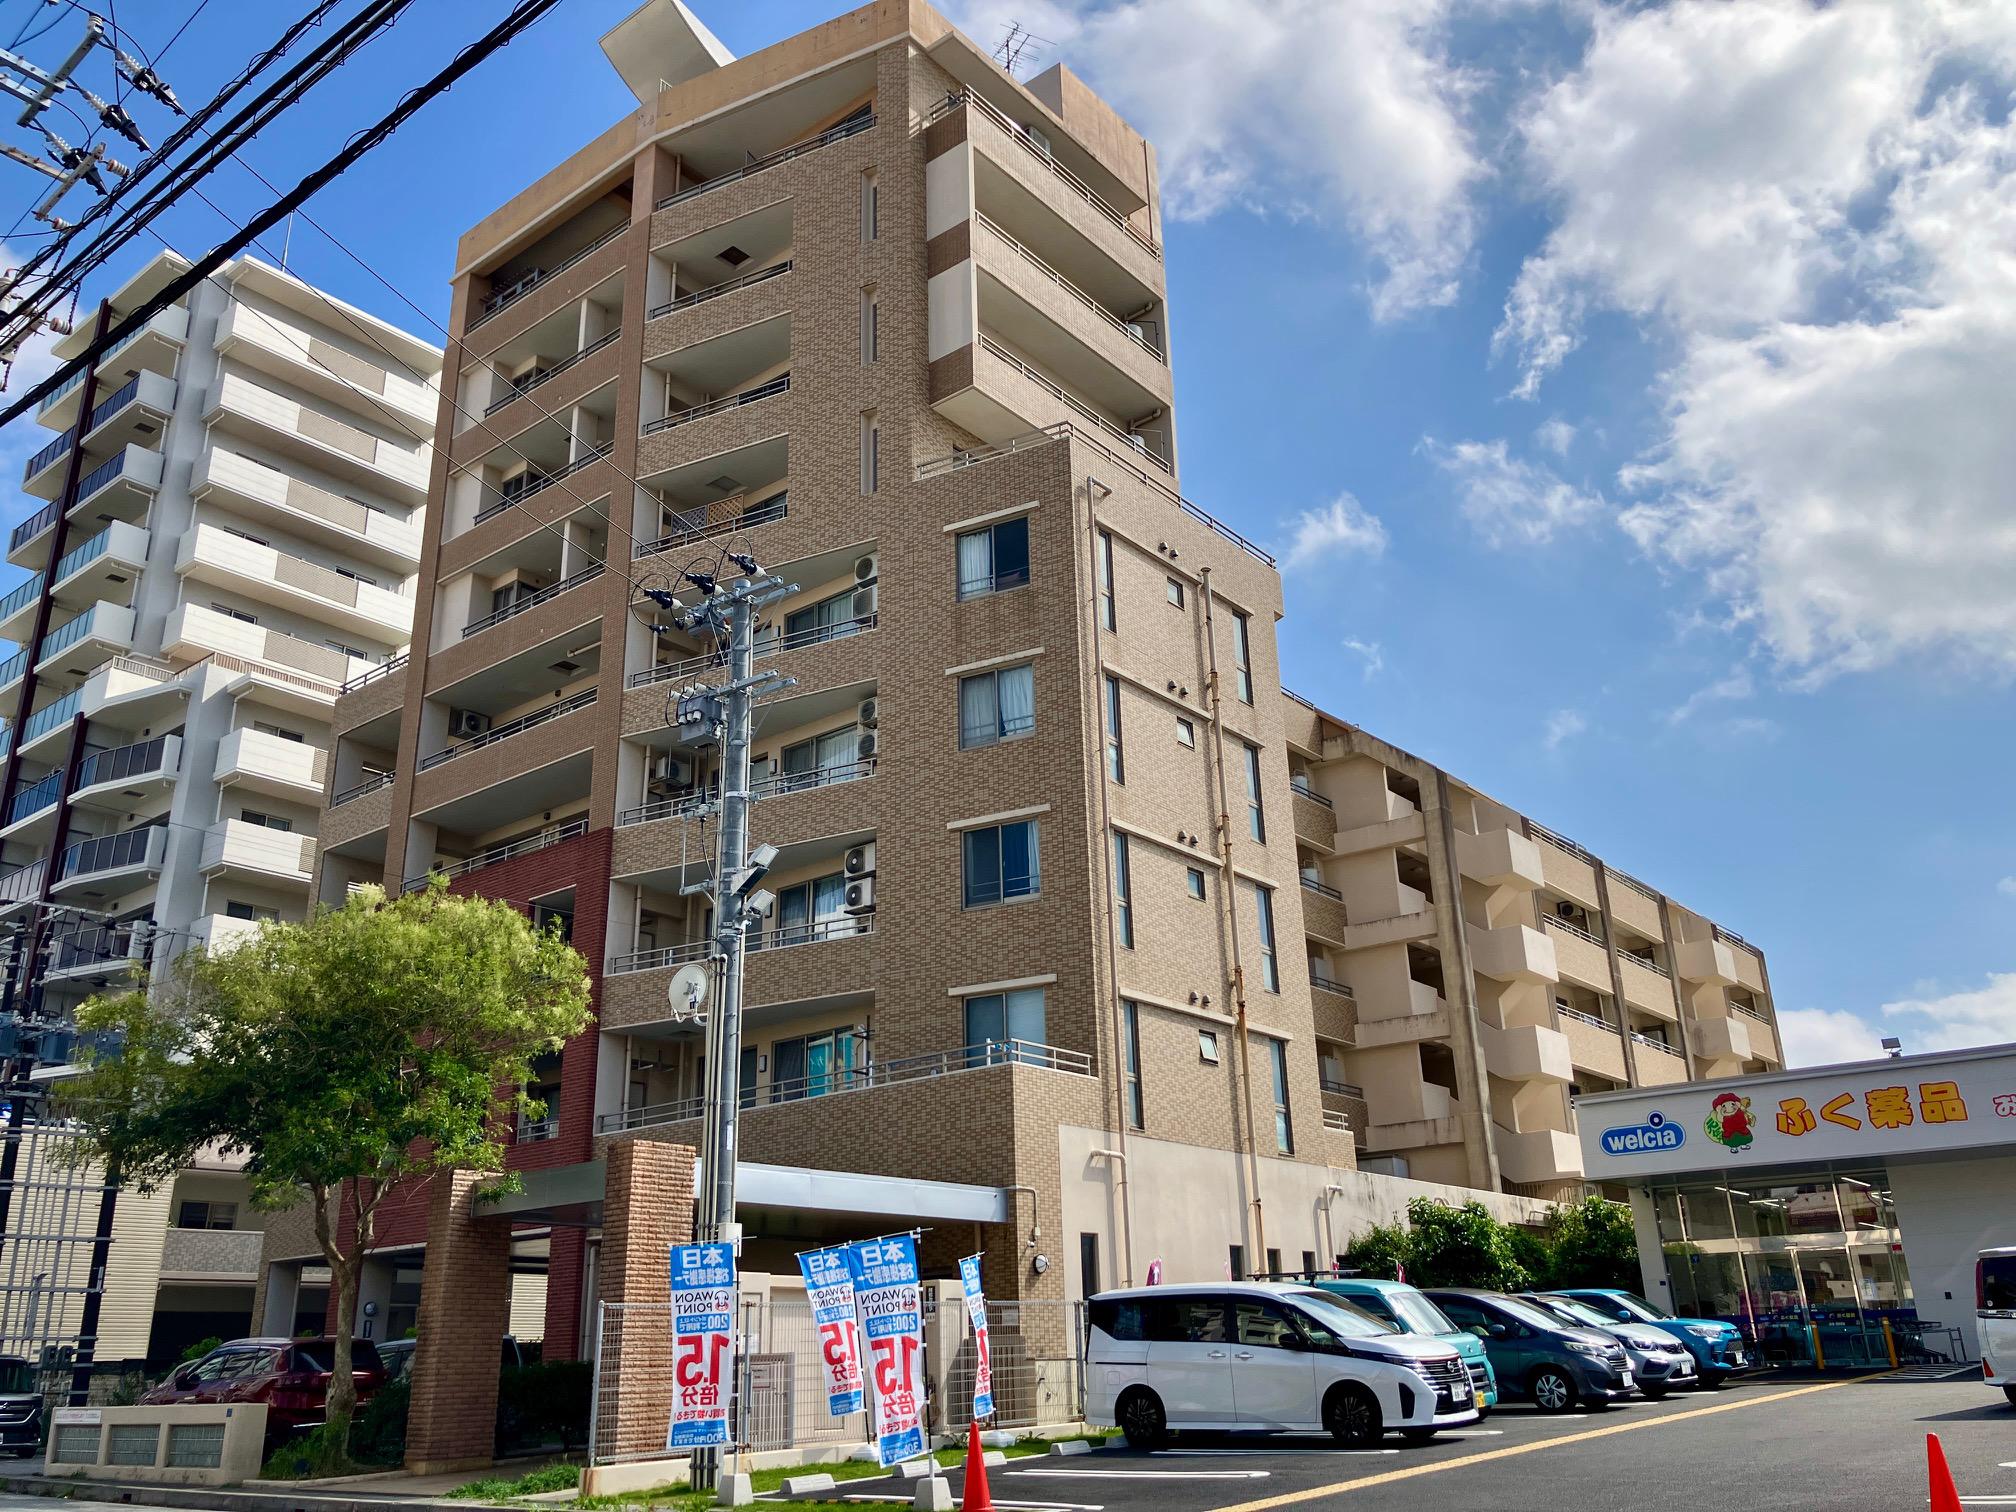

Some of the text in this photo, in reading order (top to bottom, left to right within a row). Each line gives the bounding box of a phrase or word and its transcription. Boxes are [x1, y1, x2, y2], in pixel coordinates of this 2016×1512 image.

[1776, 1081, 1969, 1136] ふく薬品
[1607, 1122, 1678, 1151] welcia
